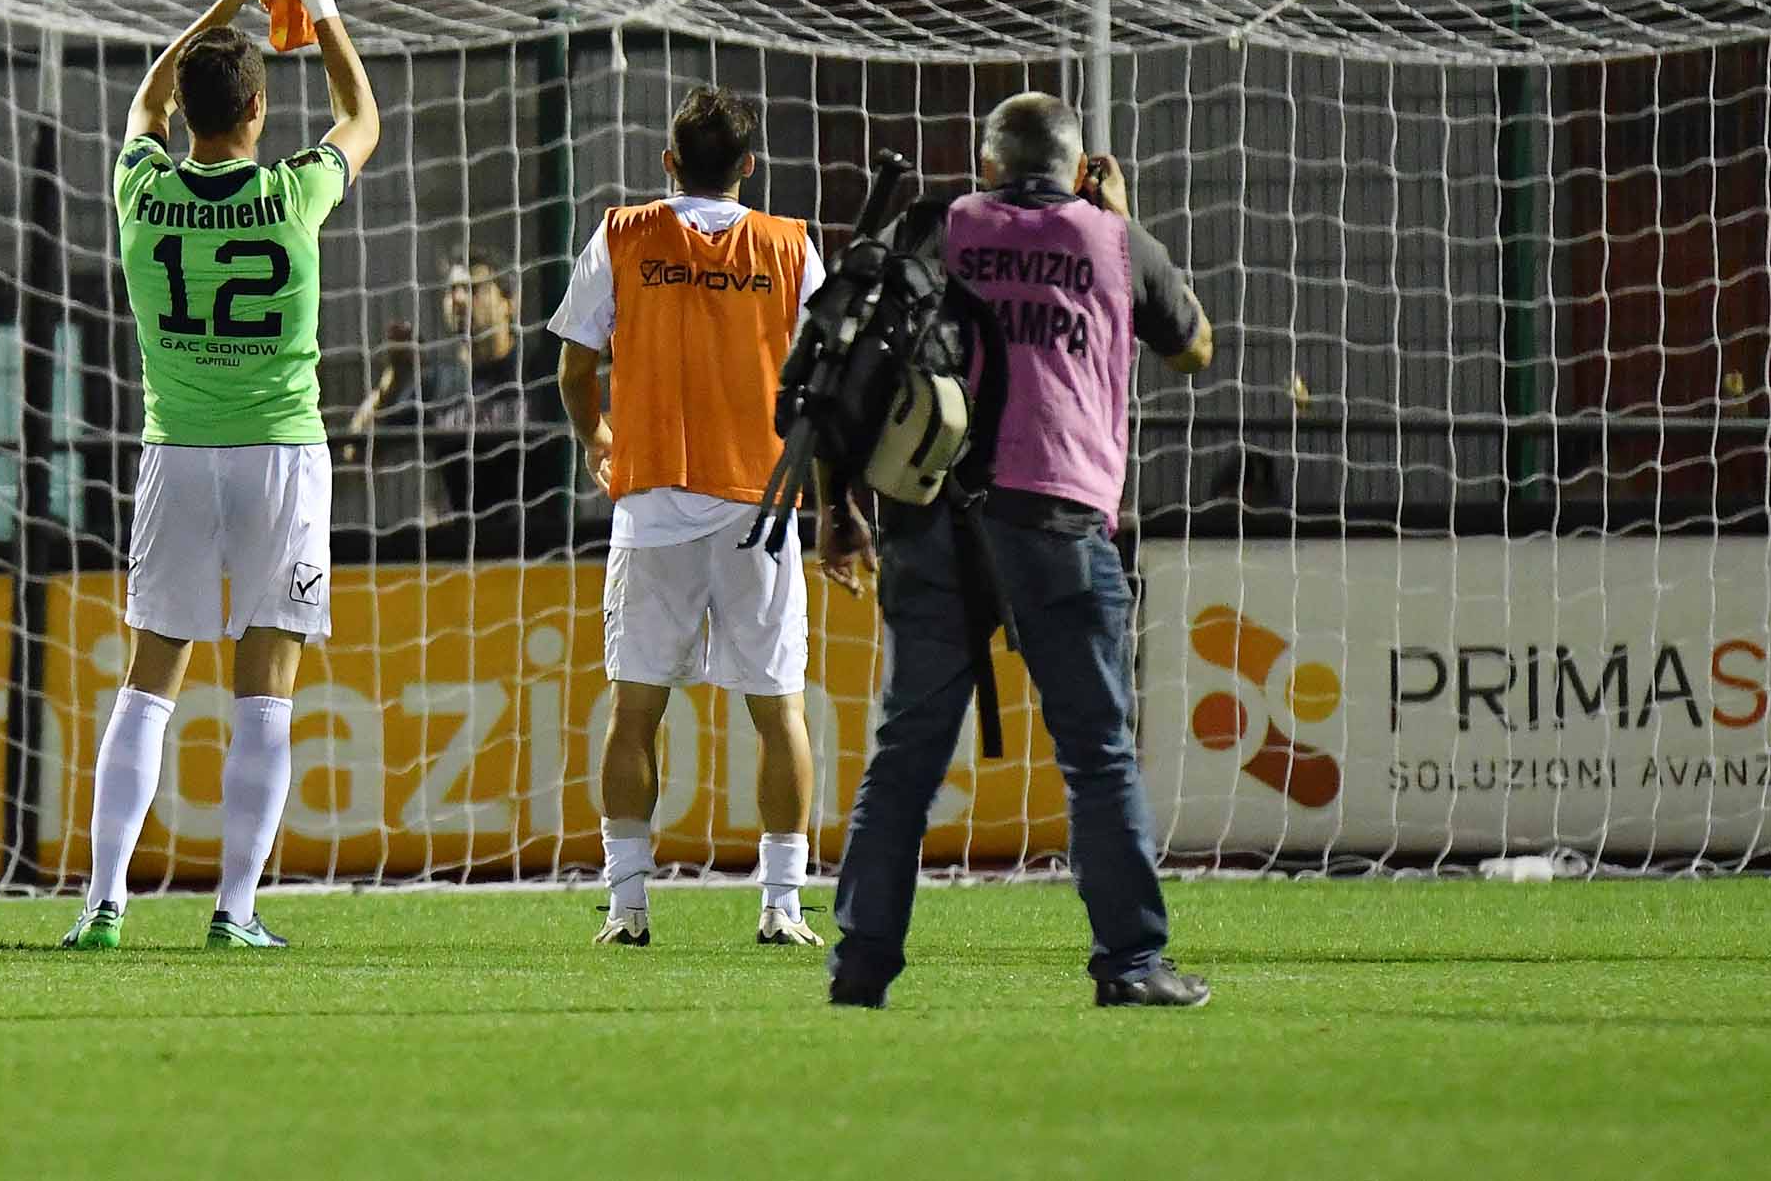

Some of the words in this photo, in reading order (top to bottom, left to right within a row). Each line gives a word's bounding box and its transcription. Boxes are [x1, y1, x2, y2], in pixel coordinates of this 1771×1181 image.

[136, 192, 287, 230] Fontanelli
[152, 234, 291, 337] 12
[958, 247, 1095, 294] SERVIZIO
[160, 337, 201, 353] GAC
[205, 342, 279, 356] GONOW
[988, 299, 1088, 358] AMPA
[1388, 639, 1768, 733] PRIMAS
[1388, 755, 1617, 792] SOLUZIONI
